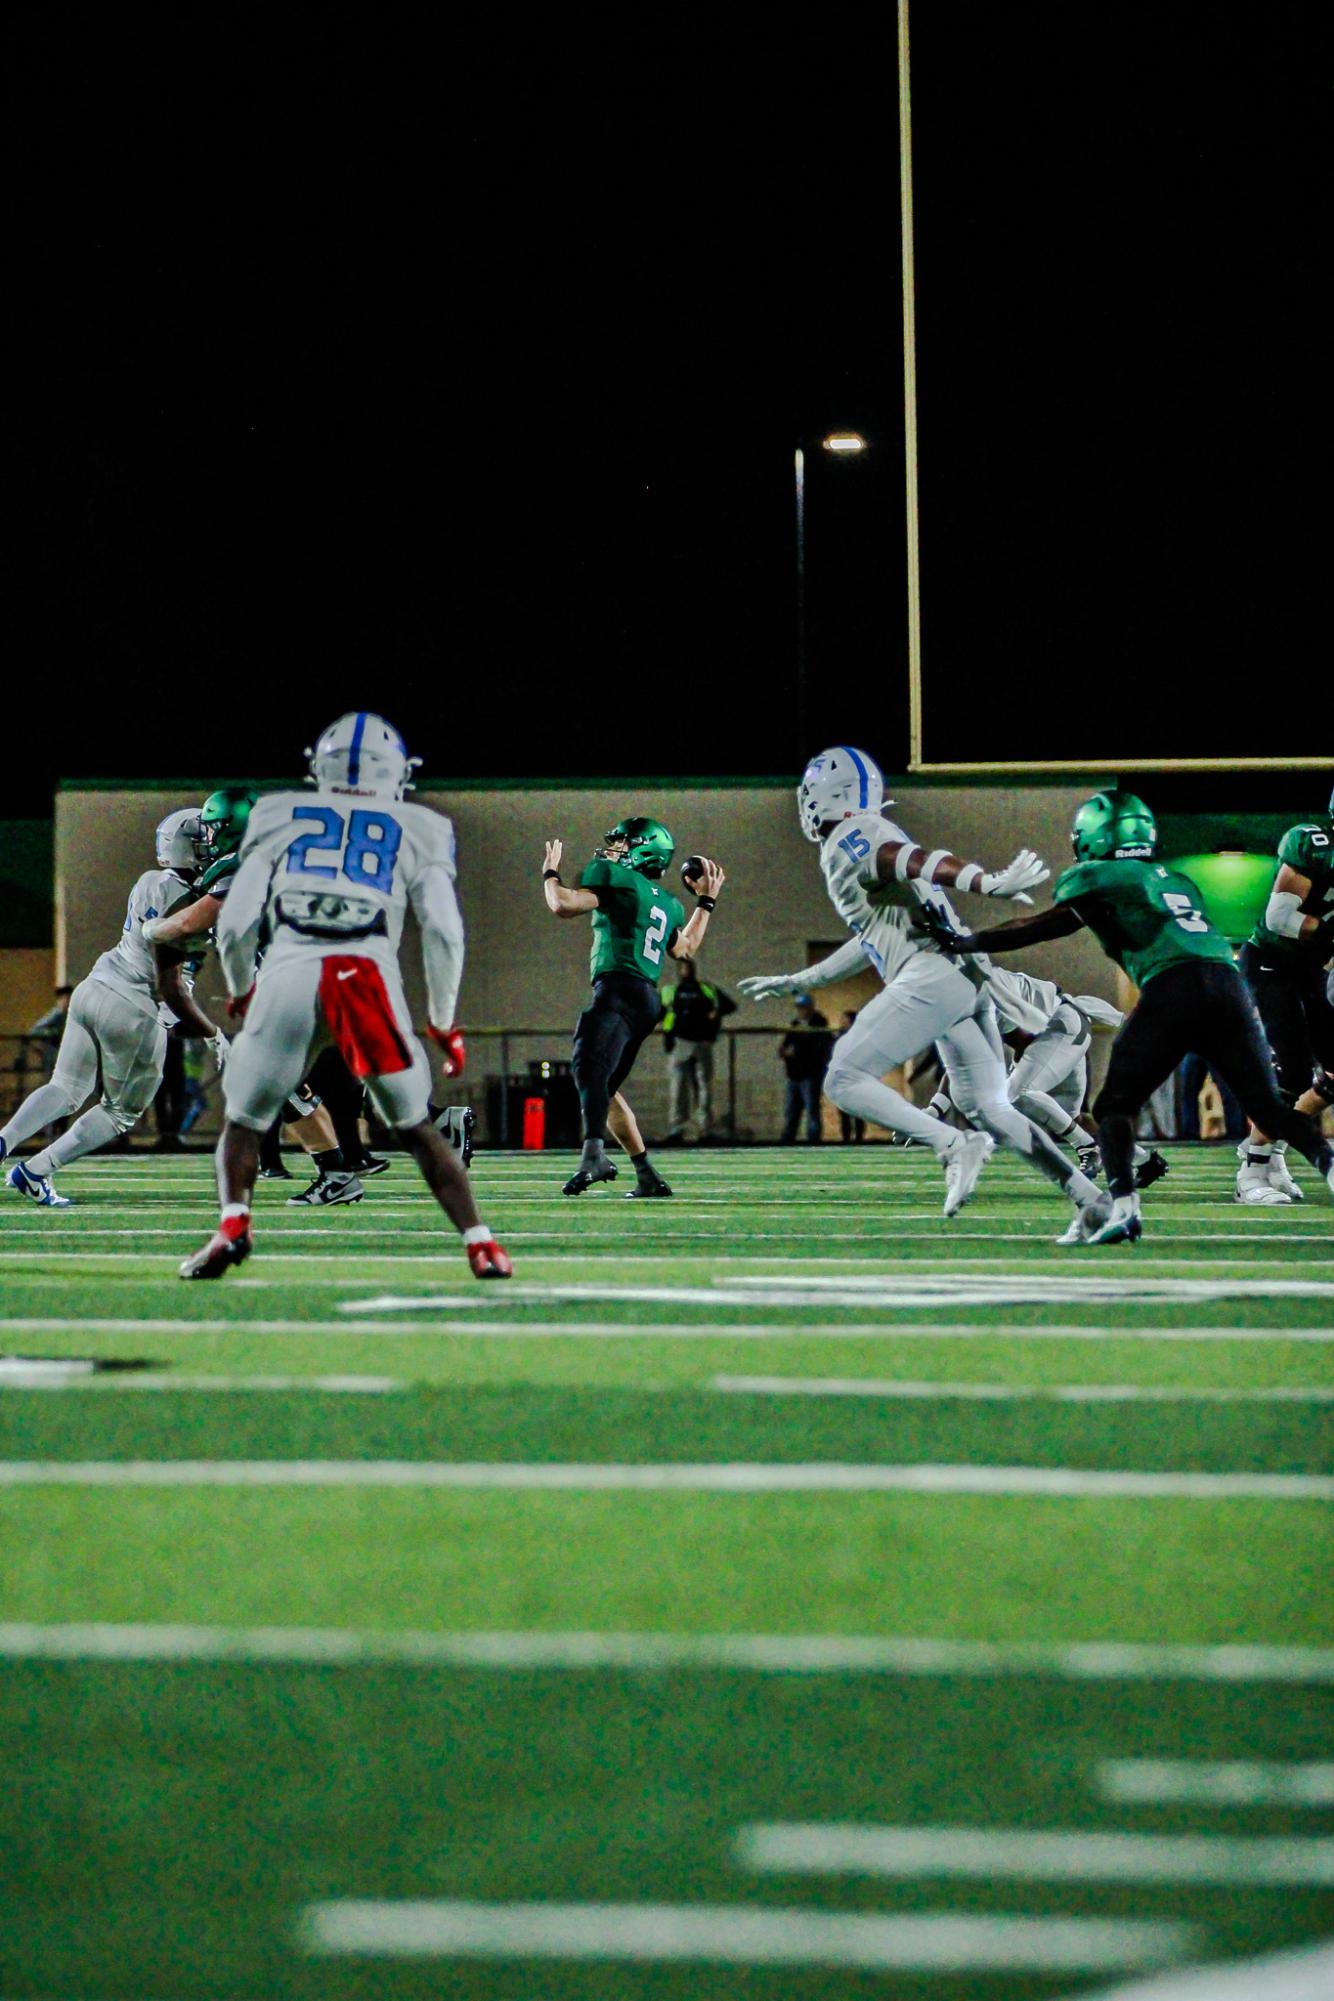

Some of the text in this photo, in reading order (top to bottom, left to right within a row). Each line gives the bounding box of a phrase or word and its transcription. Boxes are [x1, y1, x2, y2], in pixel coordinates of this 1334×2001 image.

[286, 806, 403, 896] 28
[837, 828, 871, 865] 15
[643, 905, 668, 965] 2
[1162, 892, 1209, 933] 5
